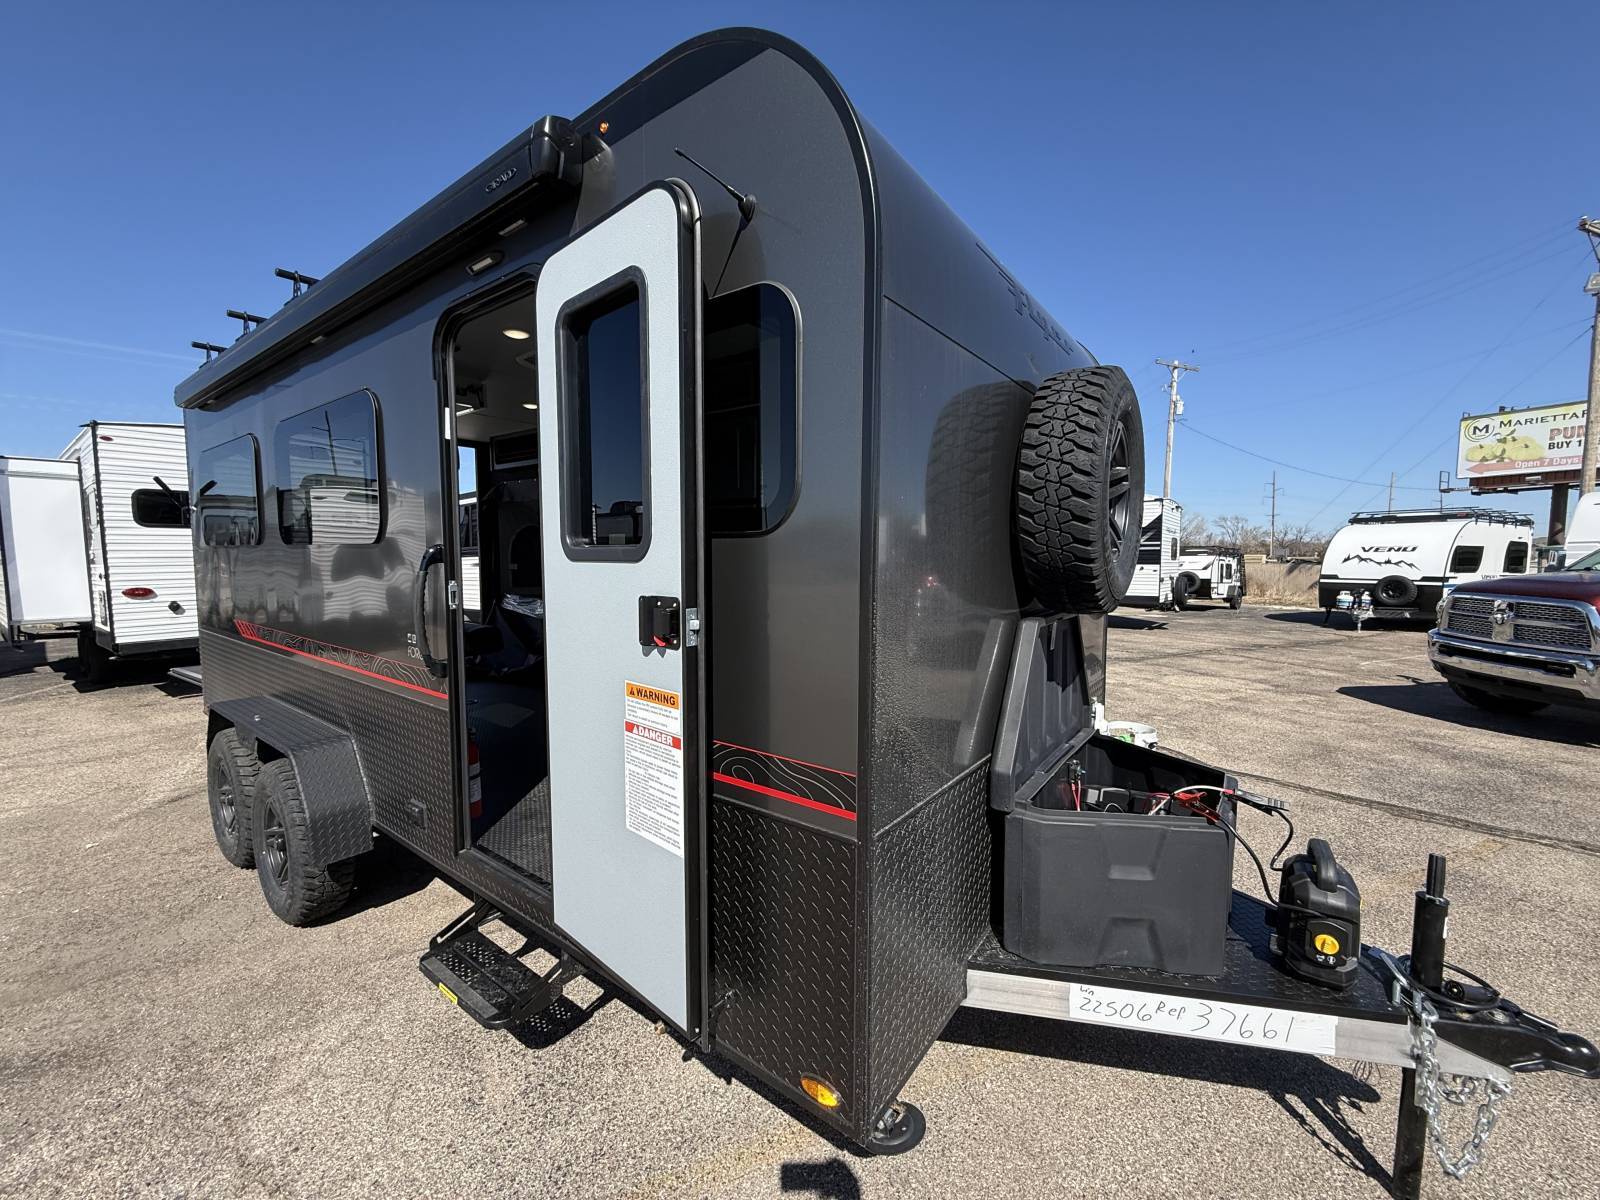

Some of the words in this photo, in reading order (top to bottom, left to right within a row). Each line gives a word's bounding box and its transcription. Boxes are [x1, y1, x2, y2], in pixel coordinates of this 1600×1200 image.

[1472, 424, 1490, 435] M
[1548, 440, 1574, 450] BUY
[1515, 460, 1540, 469] Open
[1552, 457, 1579, 466] Days
[635, 687, 676, 706] WARNING
[638, 725, 673, 747] DANGER
[1079, 996, 1152, 1022] 22506
[1190, 1002, 1295, 1043] 37661
